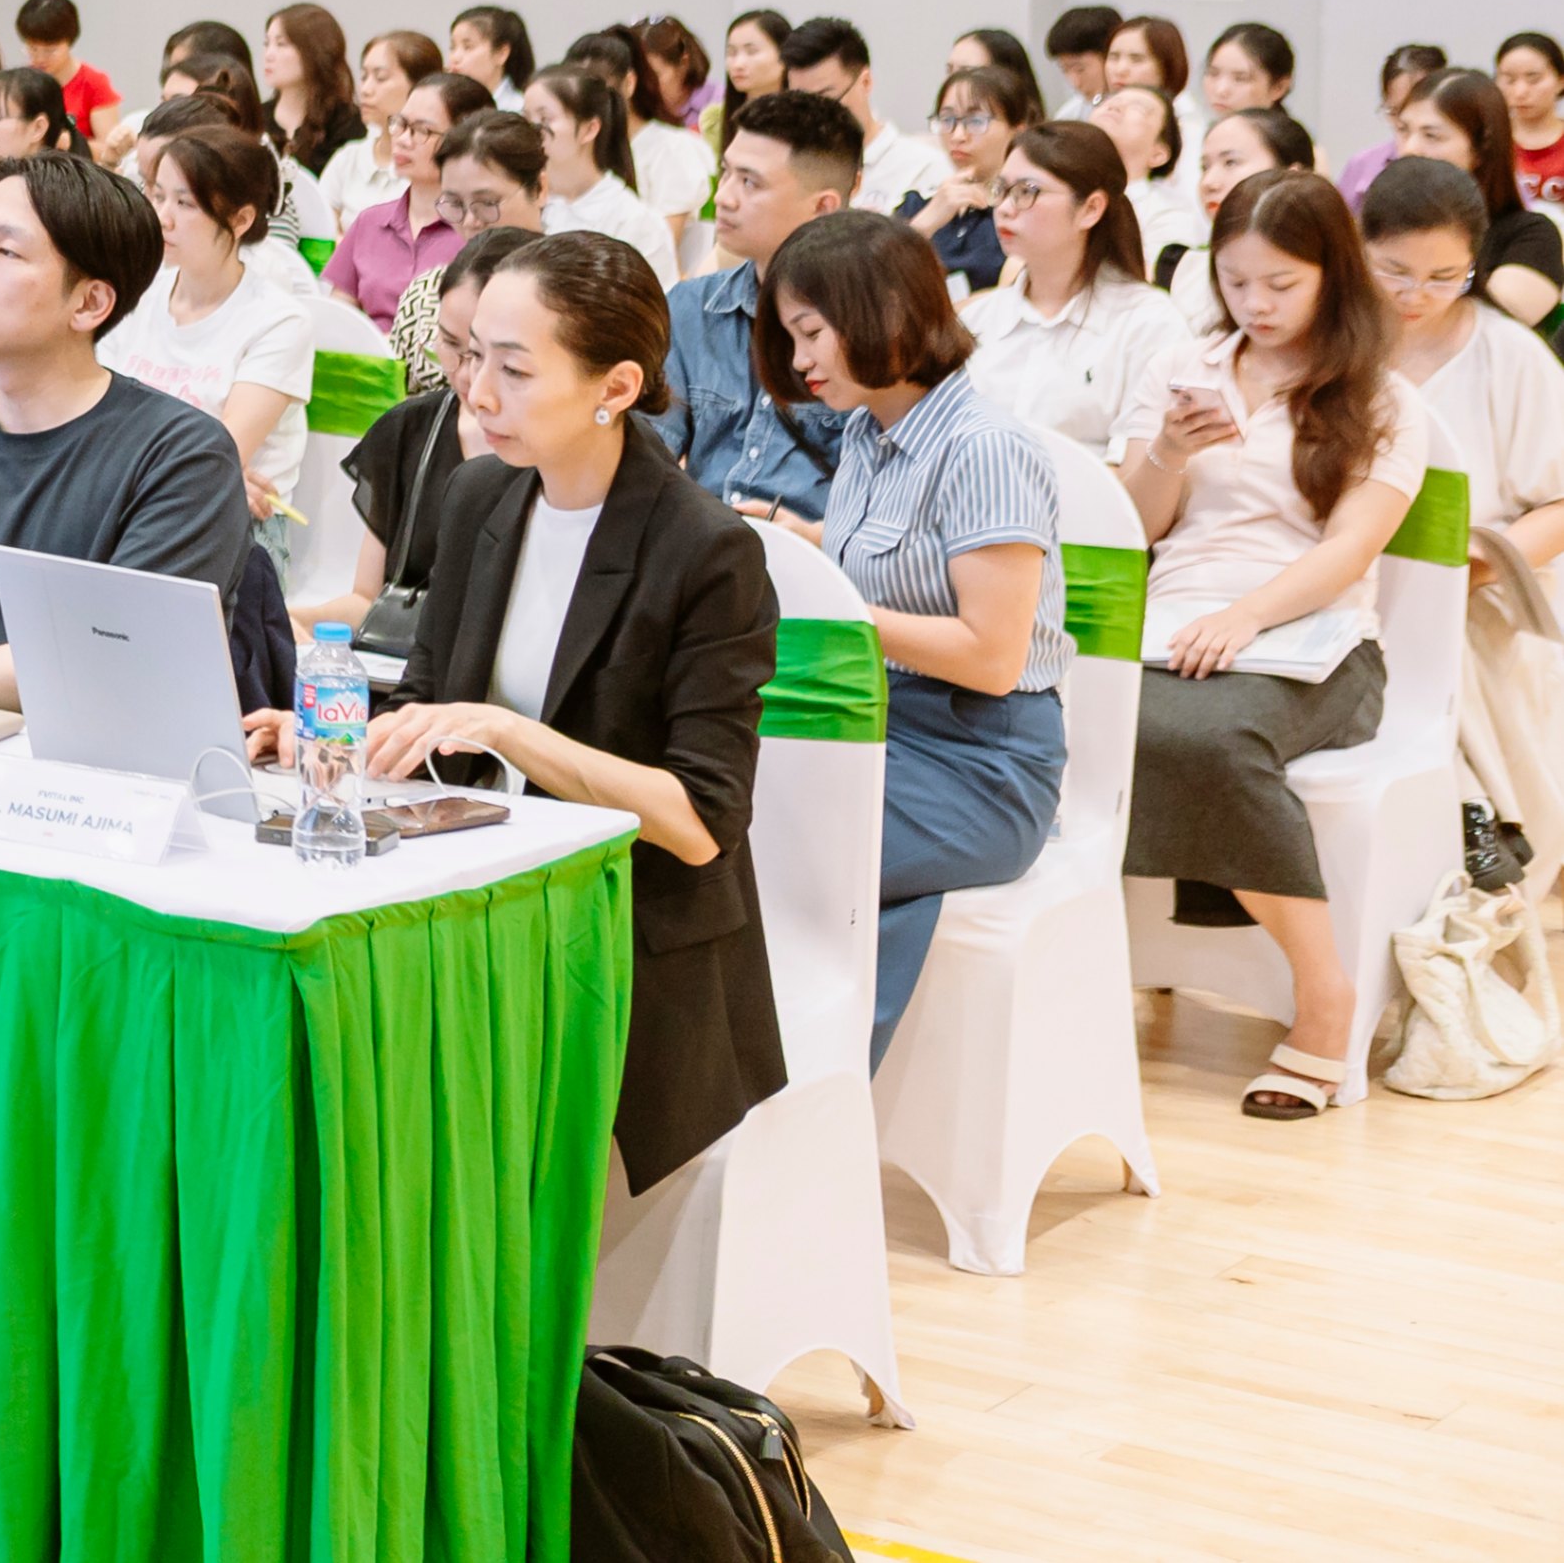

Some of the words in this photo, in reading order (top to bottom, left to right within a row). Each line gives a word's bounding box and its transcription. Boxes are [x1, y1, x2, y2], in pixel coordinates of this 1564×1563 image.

[91, 626, 130, 642] Panasonic
[7, 801, 79, 826] MASUMI
[81, 814, 134, 835] AJIMA
